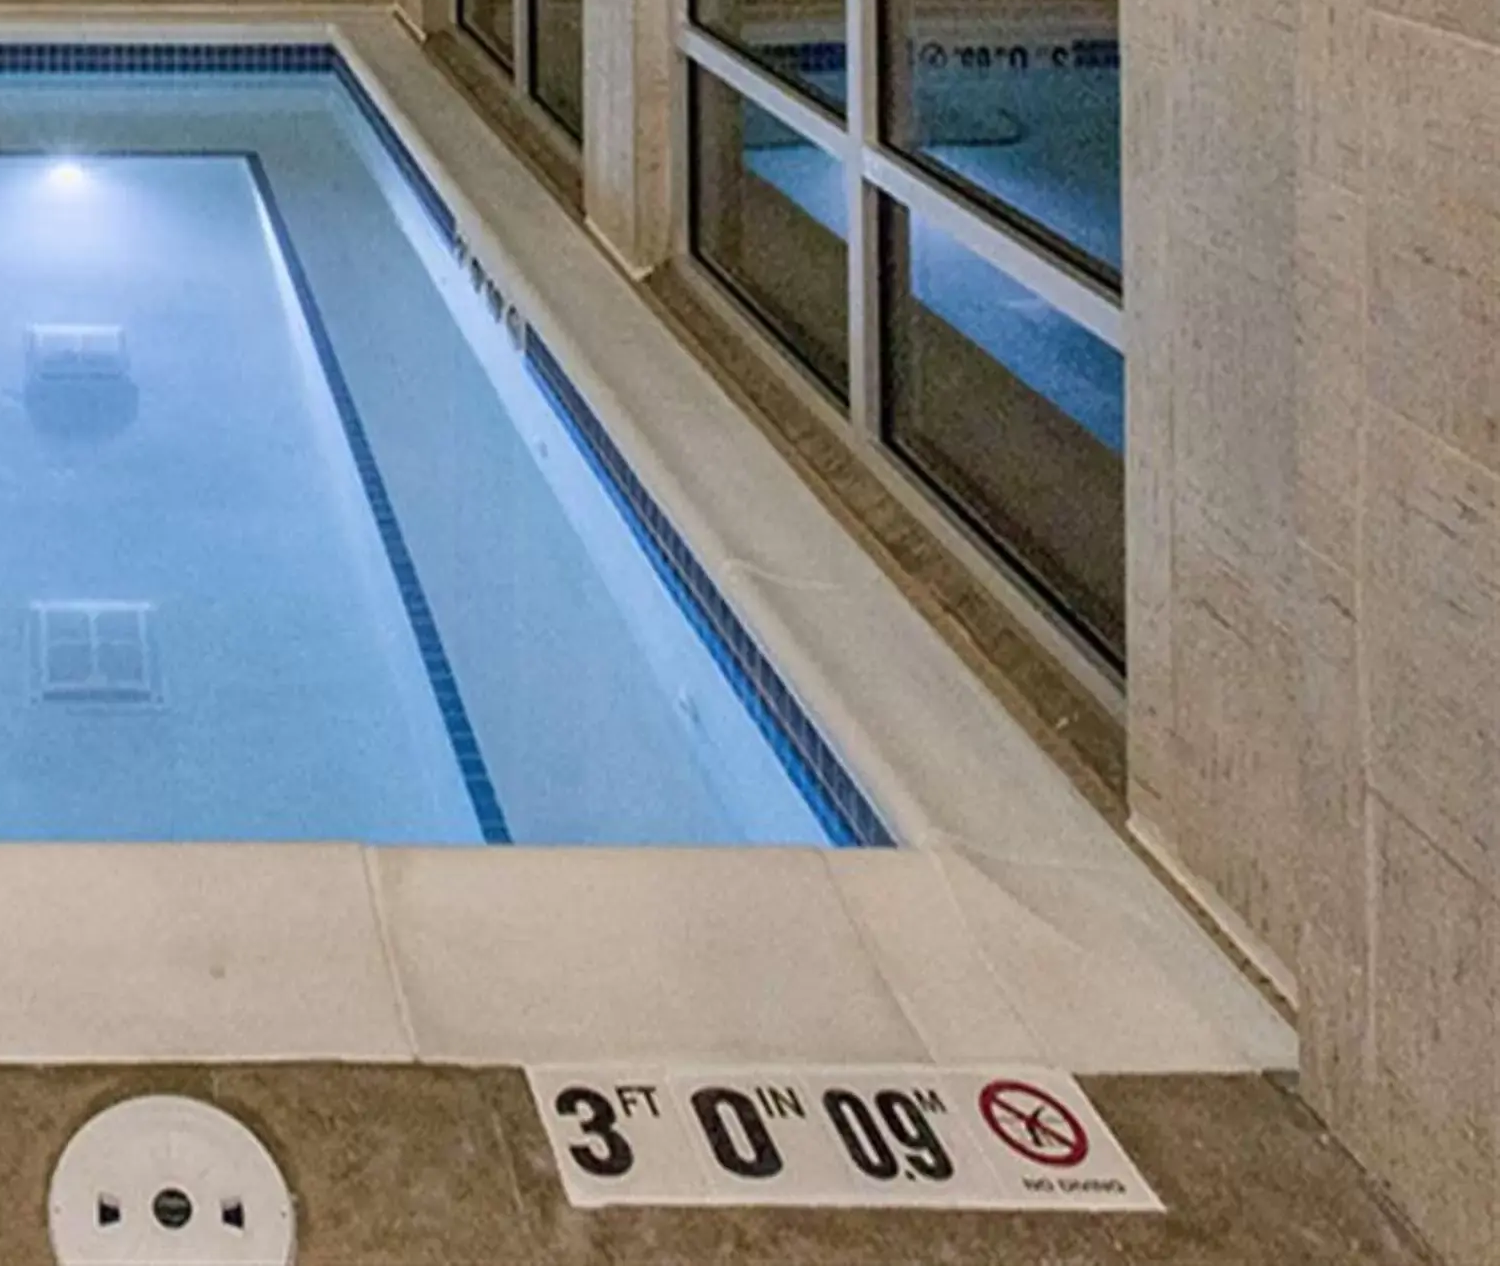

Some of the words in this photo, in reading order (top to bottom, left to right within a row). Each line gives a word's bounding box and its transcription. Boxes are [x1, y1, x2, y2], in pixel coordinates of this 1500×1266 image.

[556, 1087, 634, 1177] 3
[615, 1086, 660, 1118] FT
[691, 1087, 783, 1178] 0
[756, 1086, 806, 1118] IN
[913, 1088, 948, 1114] M
[1022, 1177, 1055, 1192] NO
[1057, 1178, 1126, 1193] DIVING
